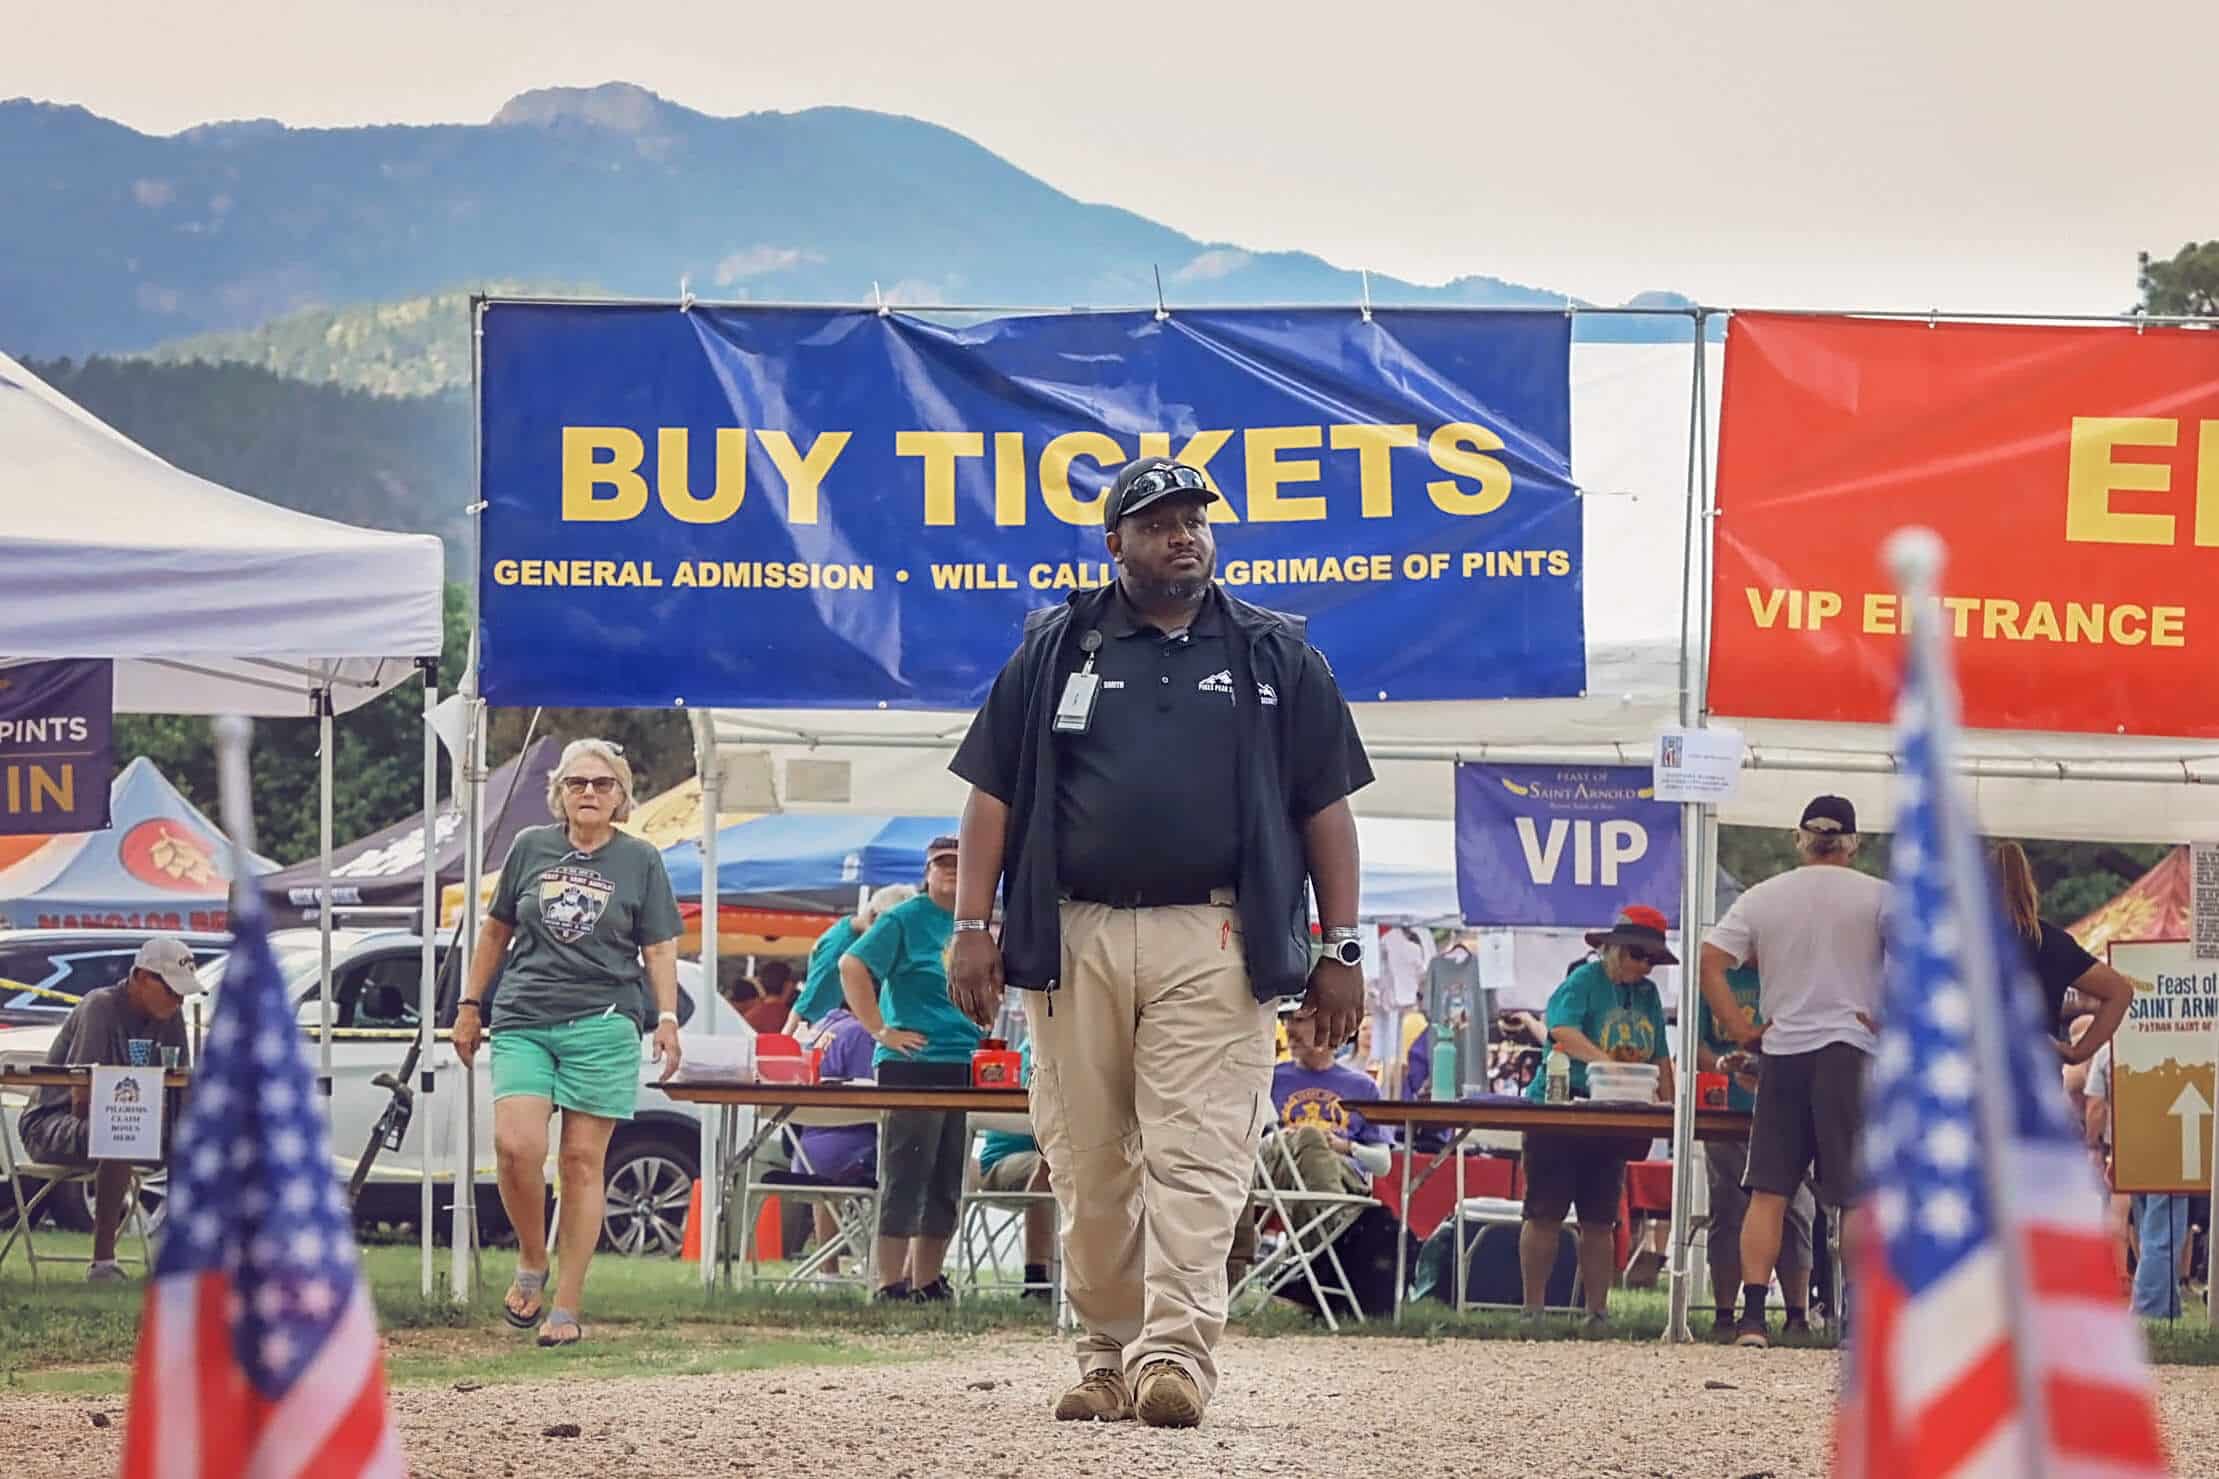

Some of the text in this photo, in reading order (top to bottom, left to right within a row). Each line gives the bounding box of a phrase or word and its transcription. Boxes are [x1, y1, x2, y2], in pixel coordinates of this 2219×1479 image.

[561, 422, 1512, 526] BUY TICKETS
[493, 550, 1571, 591] GENERAL ADMISSION WILL CALL GRIMAGE OF PINTS
[1745, 588, 1843, 631] VIP
[0, 717, 88, 743] PINTS
[7, 763, 74, 814] IN
[1514, 816, 1649, 887] VIP
[2157, 973, 2198, 996] Feast
[2128, 997, 2219, 1020] SAINT ARN
